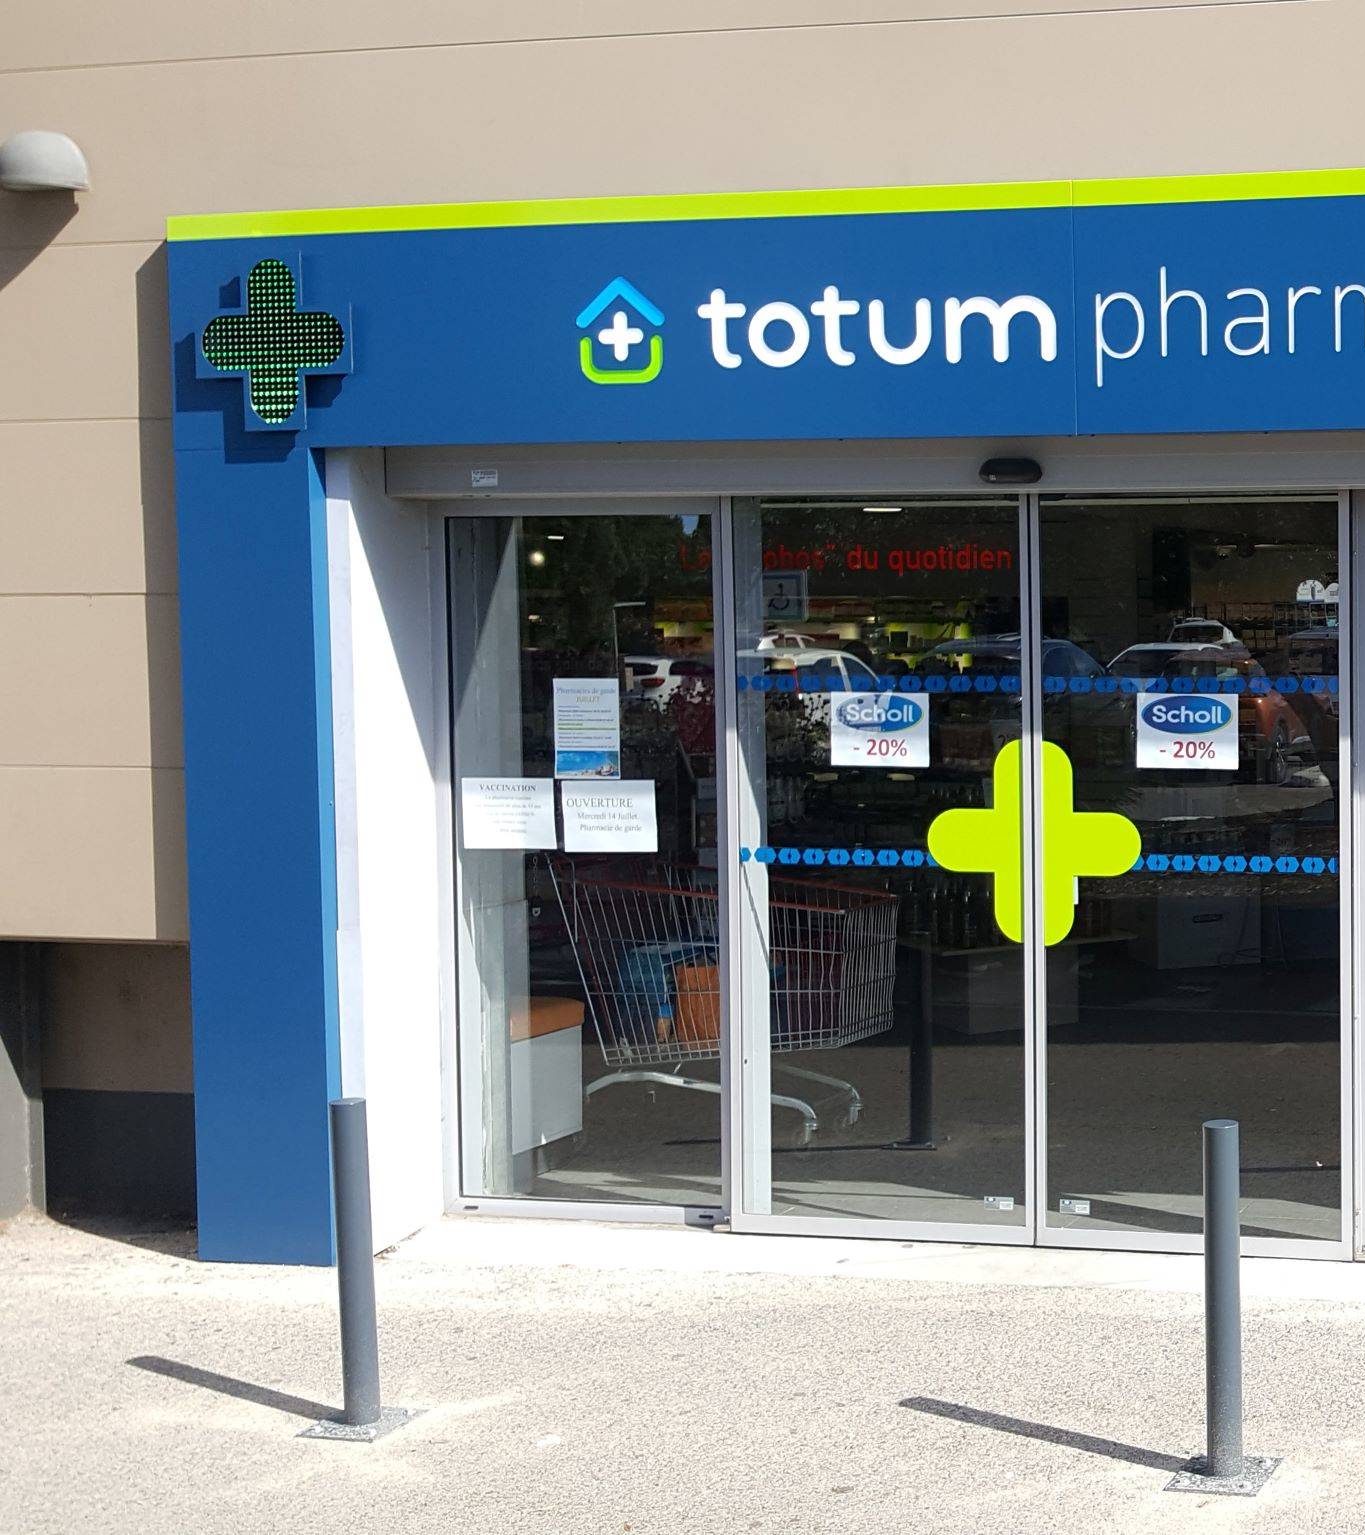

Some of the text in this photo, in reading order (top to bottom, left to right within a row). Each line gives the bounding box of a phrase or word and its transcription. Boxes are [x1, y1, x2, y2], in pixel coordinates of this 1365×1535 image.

[698, 285, 1057, 369] totum
[848, 545, 878, 570] du
[888, 544, 1012, 576] quotidien
[846, 704, 913, 722] Scholl
[1152, 705, 1223, 724] Scholl
[866, 739, 907, 757] 20%
[1173, 741, 1215, 759] 20%
[480, 784, 536, 792] VACCINATION
[566, 798, 633, 808] OUVERTURE
[580, 824, 642, 833] Pharmacie de garde
